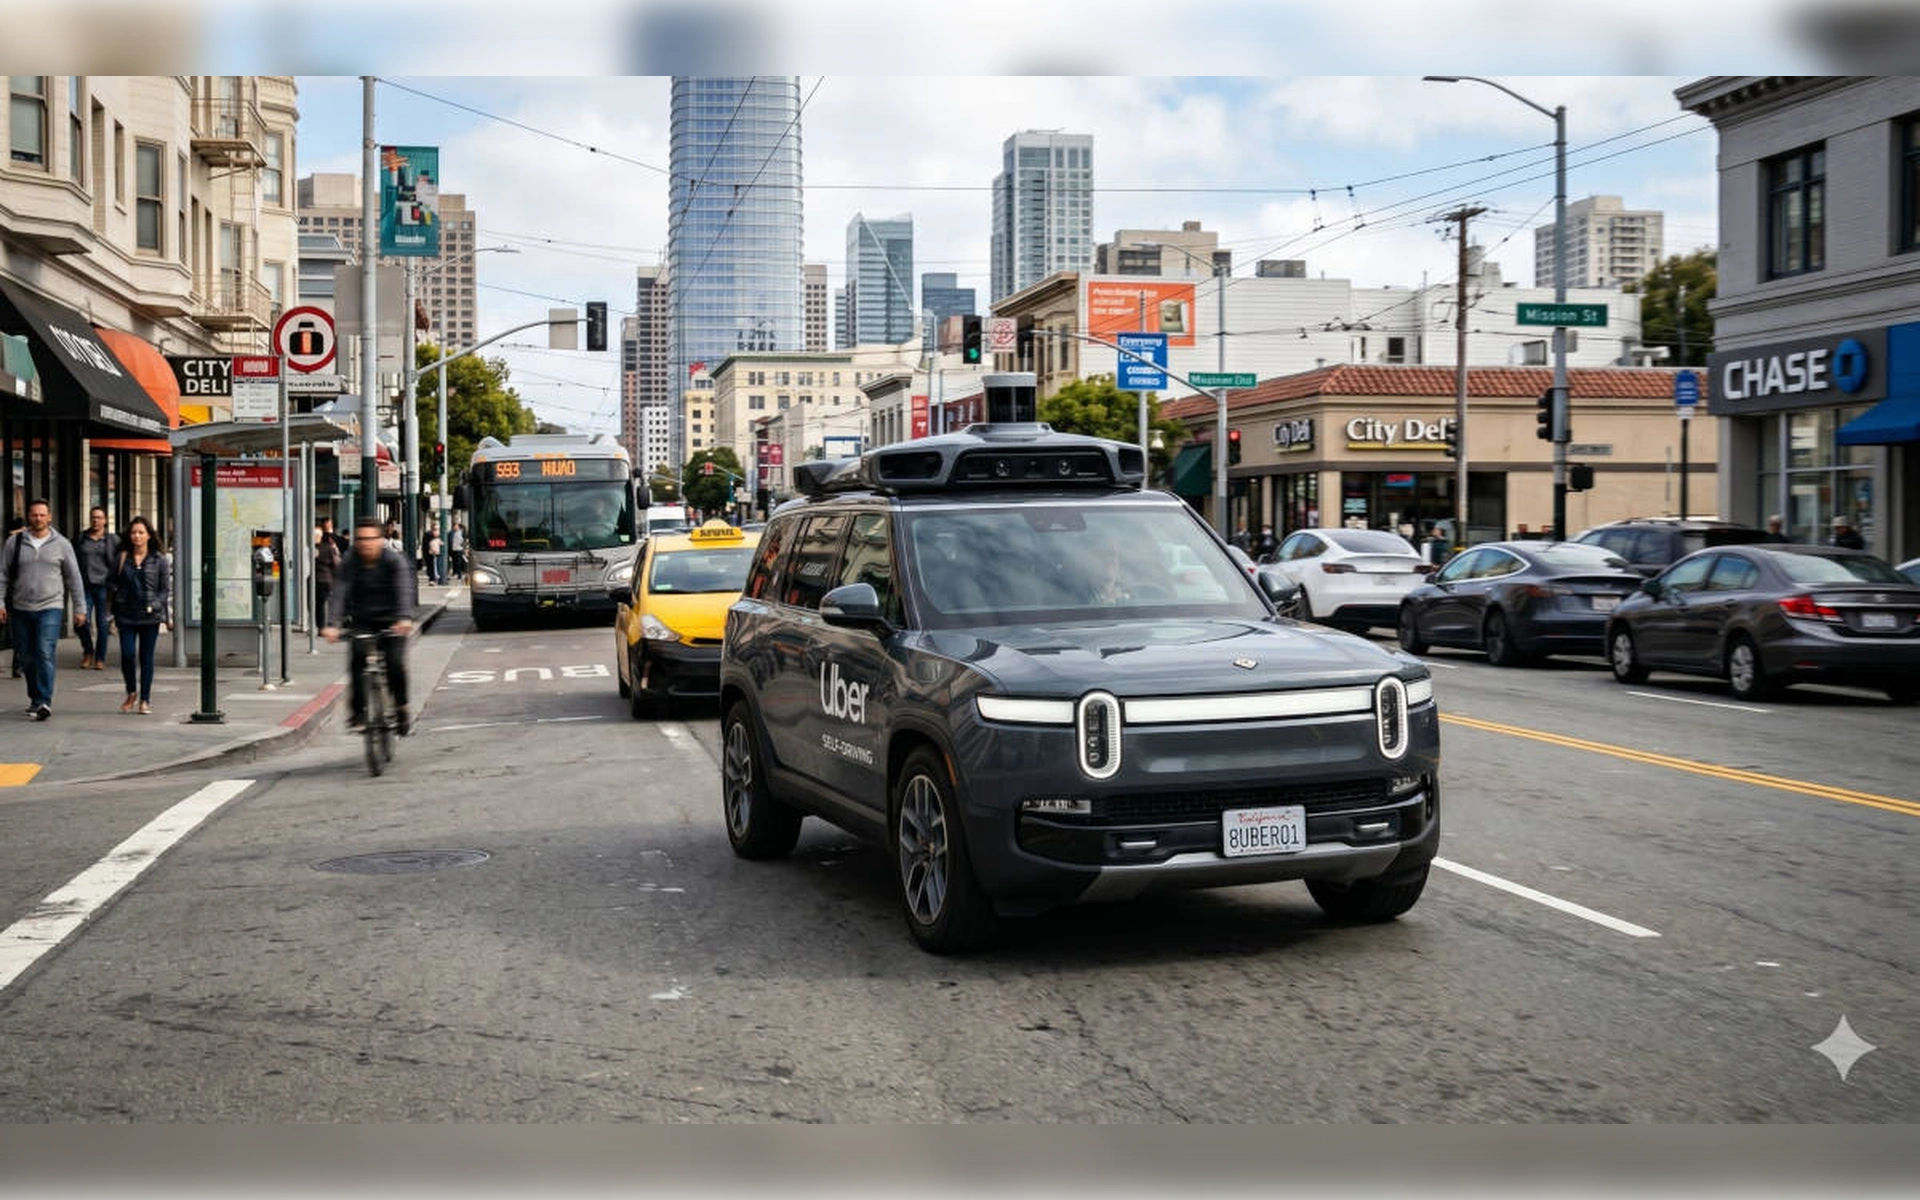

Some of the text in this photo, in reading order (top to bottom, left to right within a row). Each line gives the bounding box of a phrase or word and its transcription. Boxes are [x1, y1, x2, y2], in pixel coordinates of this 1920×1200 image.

[1525, 308, 1598, 322] Mission St
[183, 360, 231, 377] CITY
[1723, 348, 1829, 400] CHASE
[185, 378, 228, 394] DELI
[1346, 417, 1456, 445] City Del
[448, 664, 611, 684] BUS
[820, 661, 869, 725] Uber
[821, 733, 873, 765] SELF-DRIVING
[1229, 824, 1300, 849] 8UBER01
